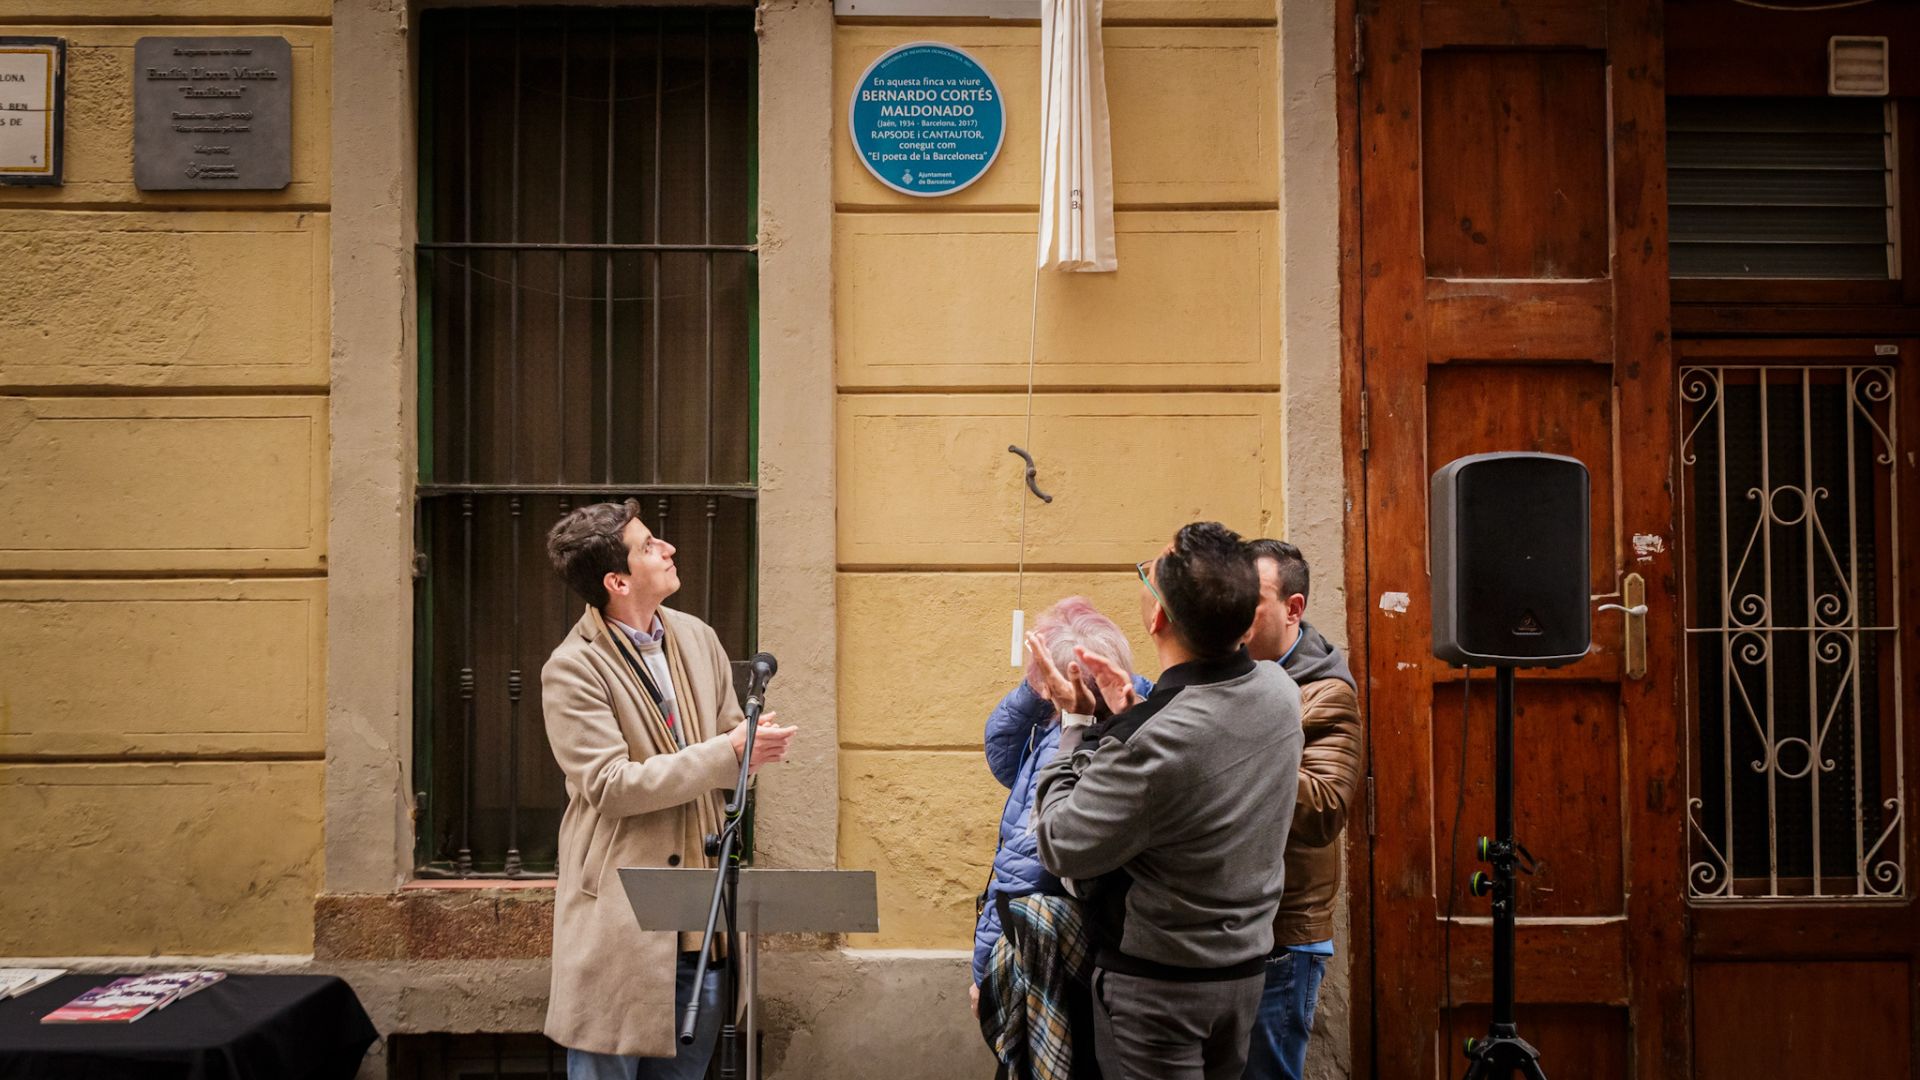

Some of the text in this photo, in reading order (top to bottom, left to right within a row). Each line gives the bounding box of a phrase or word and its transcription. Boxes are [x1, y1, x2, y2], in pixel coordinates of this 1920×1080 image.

[874, 77, 885, 86] En
[887, 78, 921, 88] aquesta
[923, 77, 944, 86] finca
[959, 77, 981, 86] viure
[862, 87, 993, 101] BERNARDO CORTÉS
[880, 105, 974, 117] MALDONADO
[877, 120, 897, 128] (Jaén,
[958, 120, 978, 128] 2017)
[871, 130, 915, 139] RAPSODE
[922, 130, 984, 140] CANTAUTOR,
[899, 141, 935, 151] conegut
[882, 153, 907, 163] poeta
[909, 152, 921, 161] de
[923, 152, 931, 161] la
